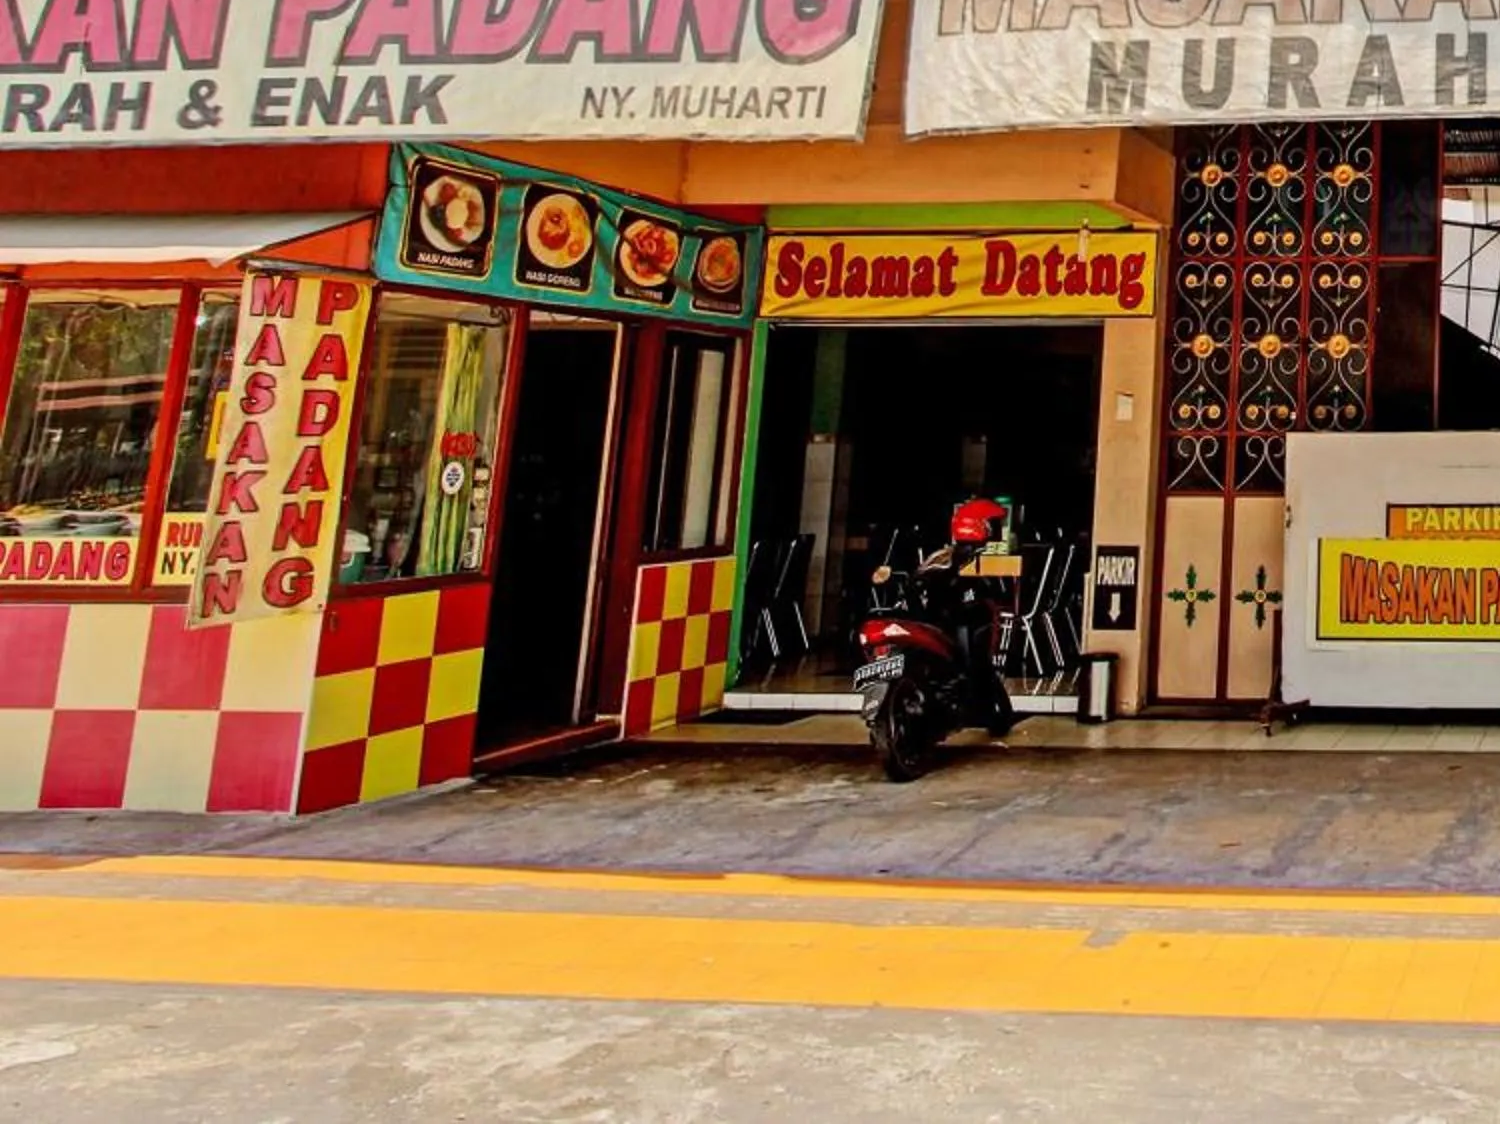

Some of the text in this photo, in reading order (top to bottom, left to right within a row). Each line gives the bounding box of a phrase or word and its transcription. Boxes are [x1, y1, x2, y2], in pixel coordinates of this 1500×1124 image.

[2, 73, 828, 132] RAH & ENAK NY. MUHARTI
[1085, 30, 1490, 114] MURAH
[774, 239, 1147, 310] Selamat Datang
[200, 276, 298, 618] MASAKAN
[262, 279, 358, 608] PADANG
[1097, 555, 1135, 585] PARKIR
[1340, 551, 1477, 625] MASAKAN
